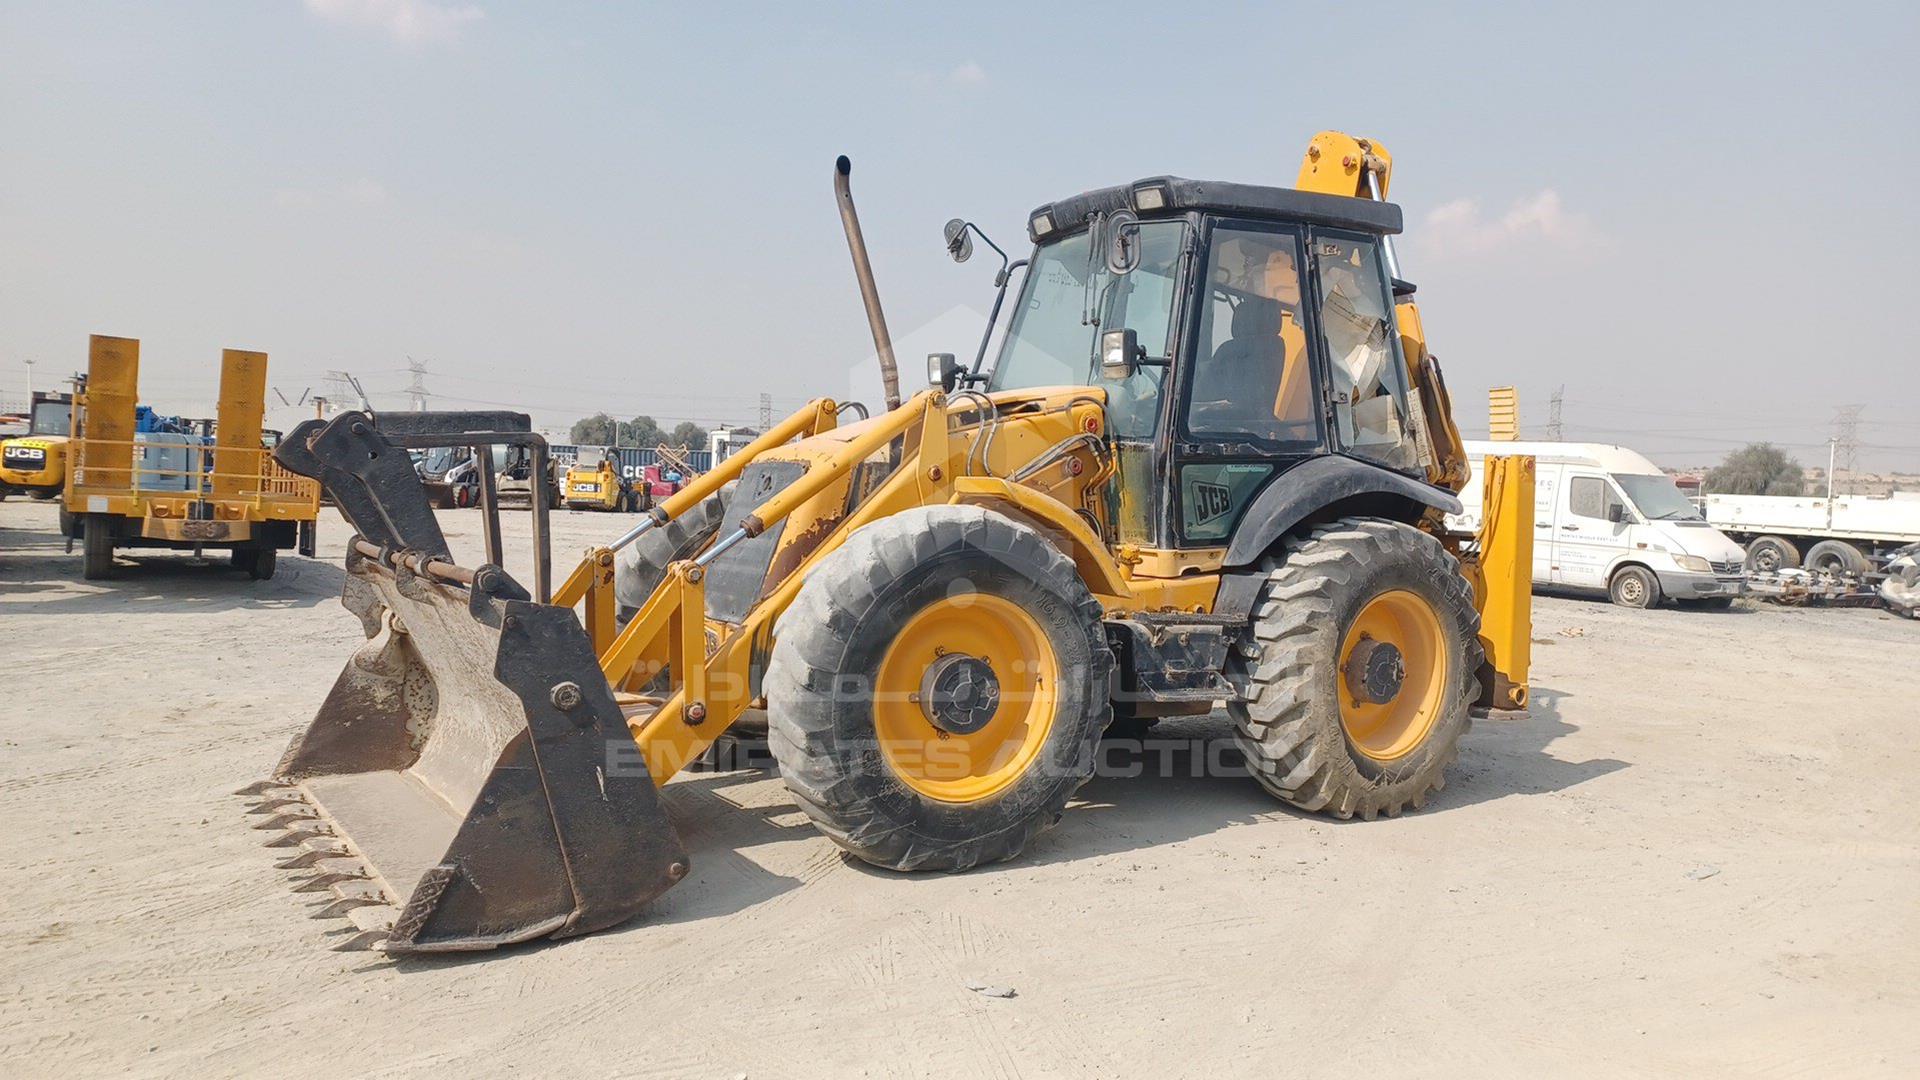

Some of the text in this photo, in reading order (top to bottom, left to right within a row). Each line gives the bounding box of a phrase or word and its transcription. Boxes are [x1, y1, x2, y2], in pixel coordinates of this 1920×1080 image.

[5, 448, 44, 459] JCB
[572, 484, 595, 492] JCB
[1197, 485, 1230, 522] JCB
